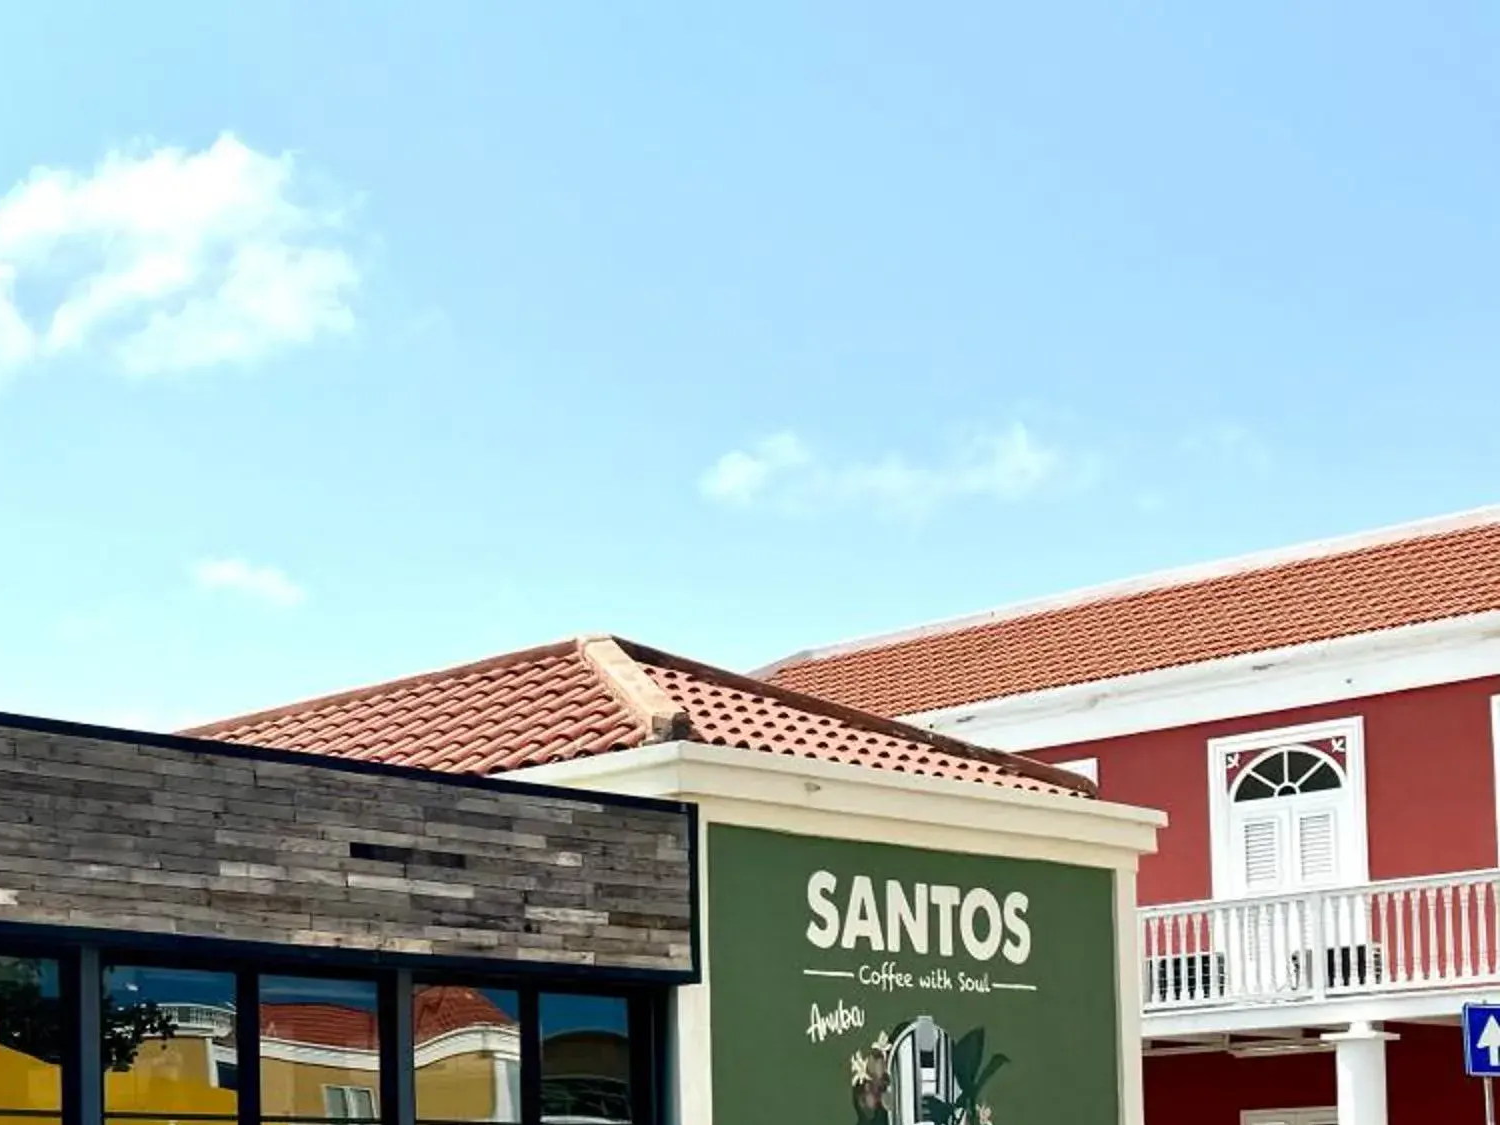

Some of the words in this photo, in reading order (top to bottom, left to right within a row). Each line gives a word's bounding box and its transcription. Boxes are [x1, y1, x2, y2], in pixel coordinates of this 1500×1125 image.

[806, 870, 1031, 965] SANTOS
[859, 961, 914, 992] Coffee
[919, 968, 953, 990] with
[957, 971, 991, 993] Soul
[806, 999, 866, 1044] Aruba
